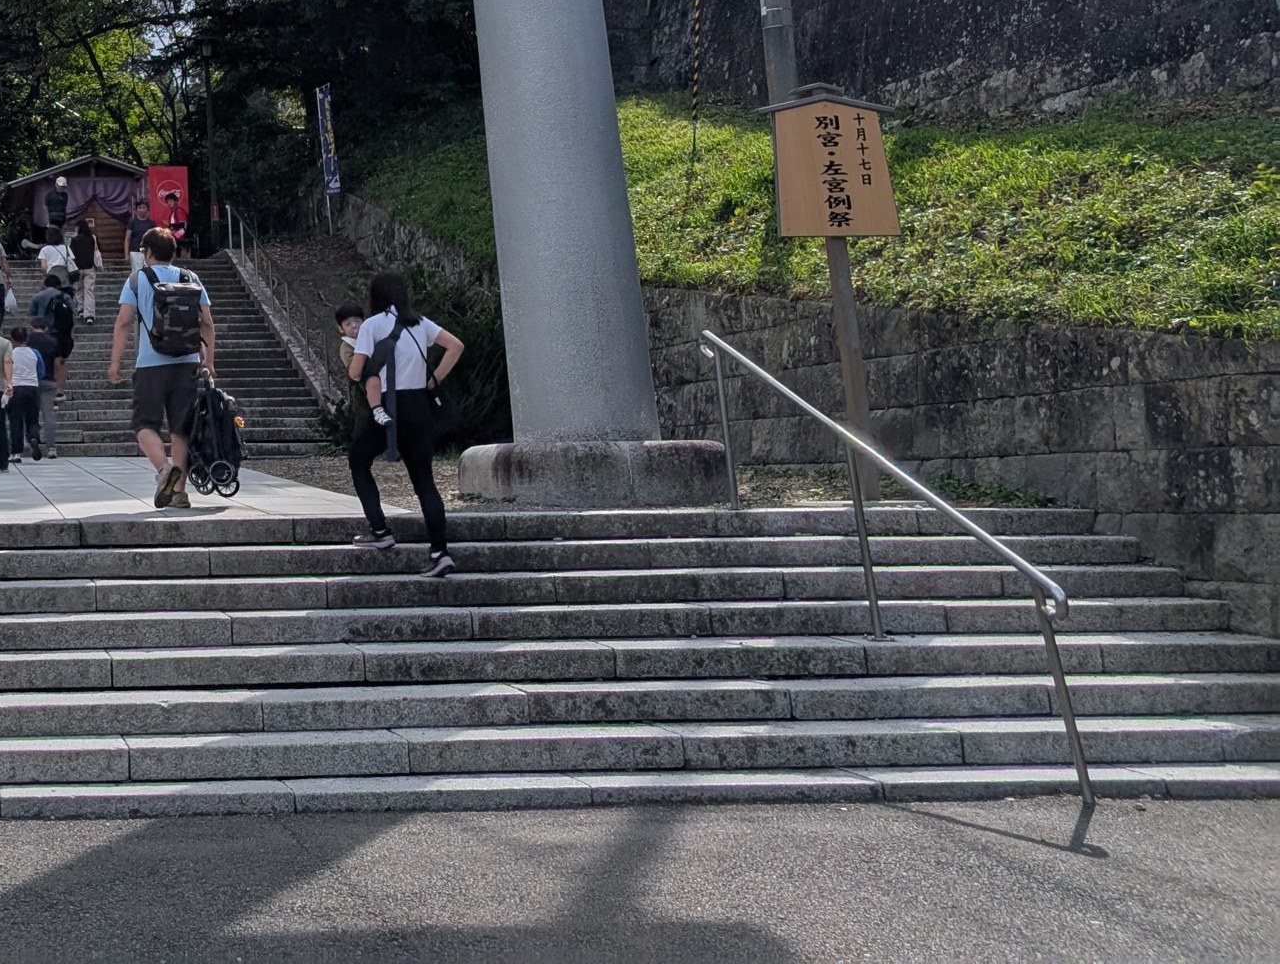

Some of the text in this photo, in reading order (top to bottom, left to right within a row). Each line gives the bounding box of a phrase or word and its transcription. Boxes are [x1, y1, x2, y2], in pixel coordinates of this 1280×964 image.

[814, 115, 854, 228] 別宮・左宮例祭
[853, 112, 872, 186] 十月十七日
